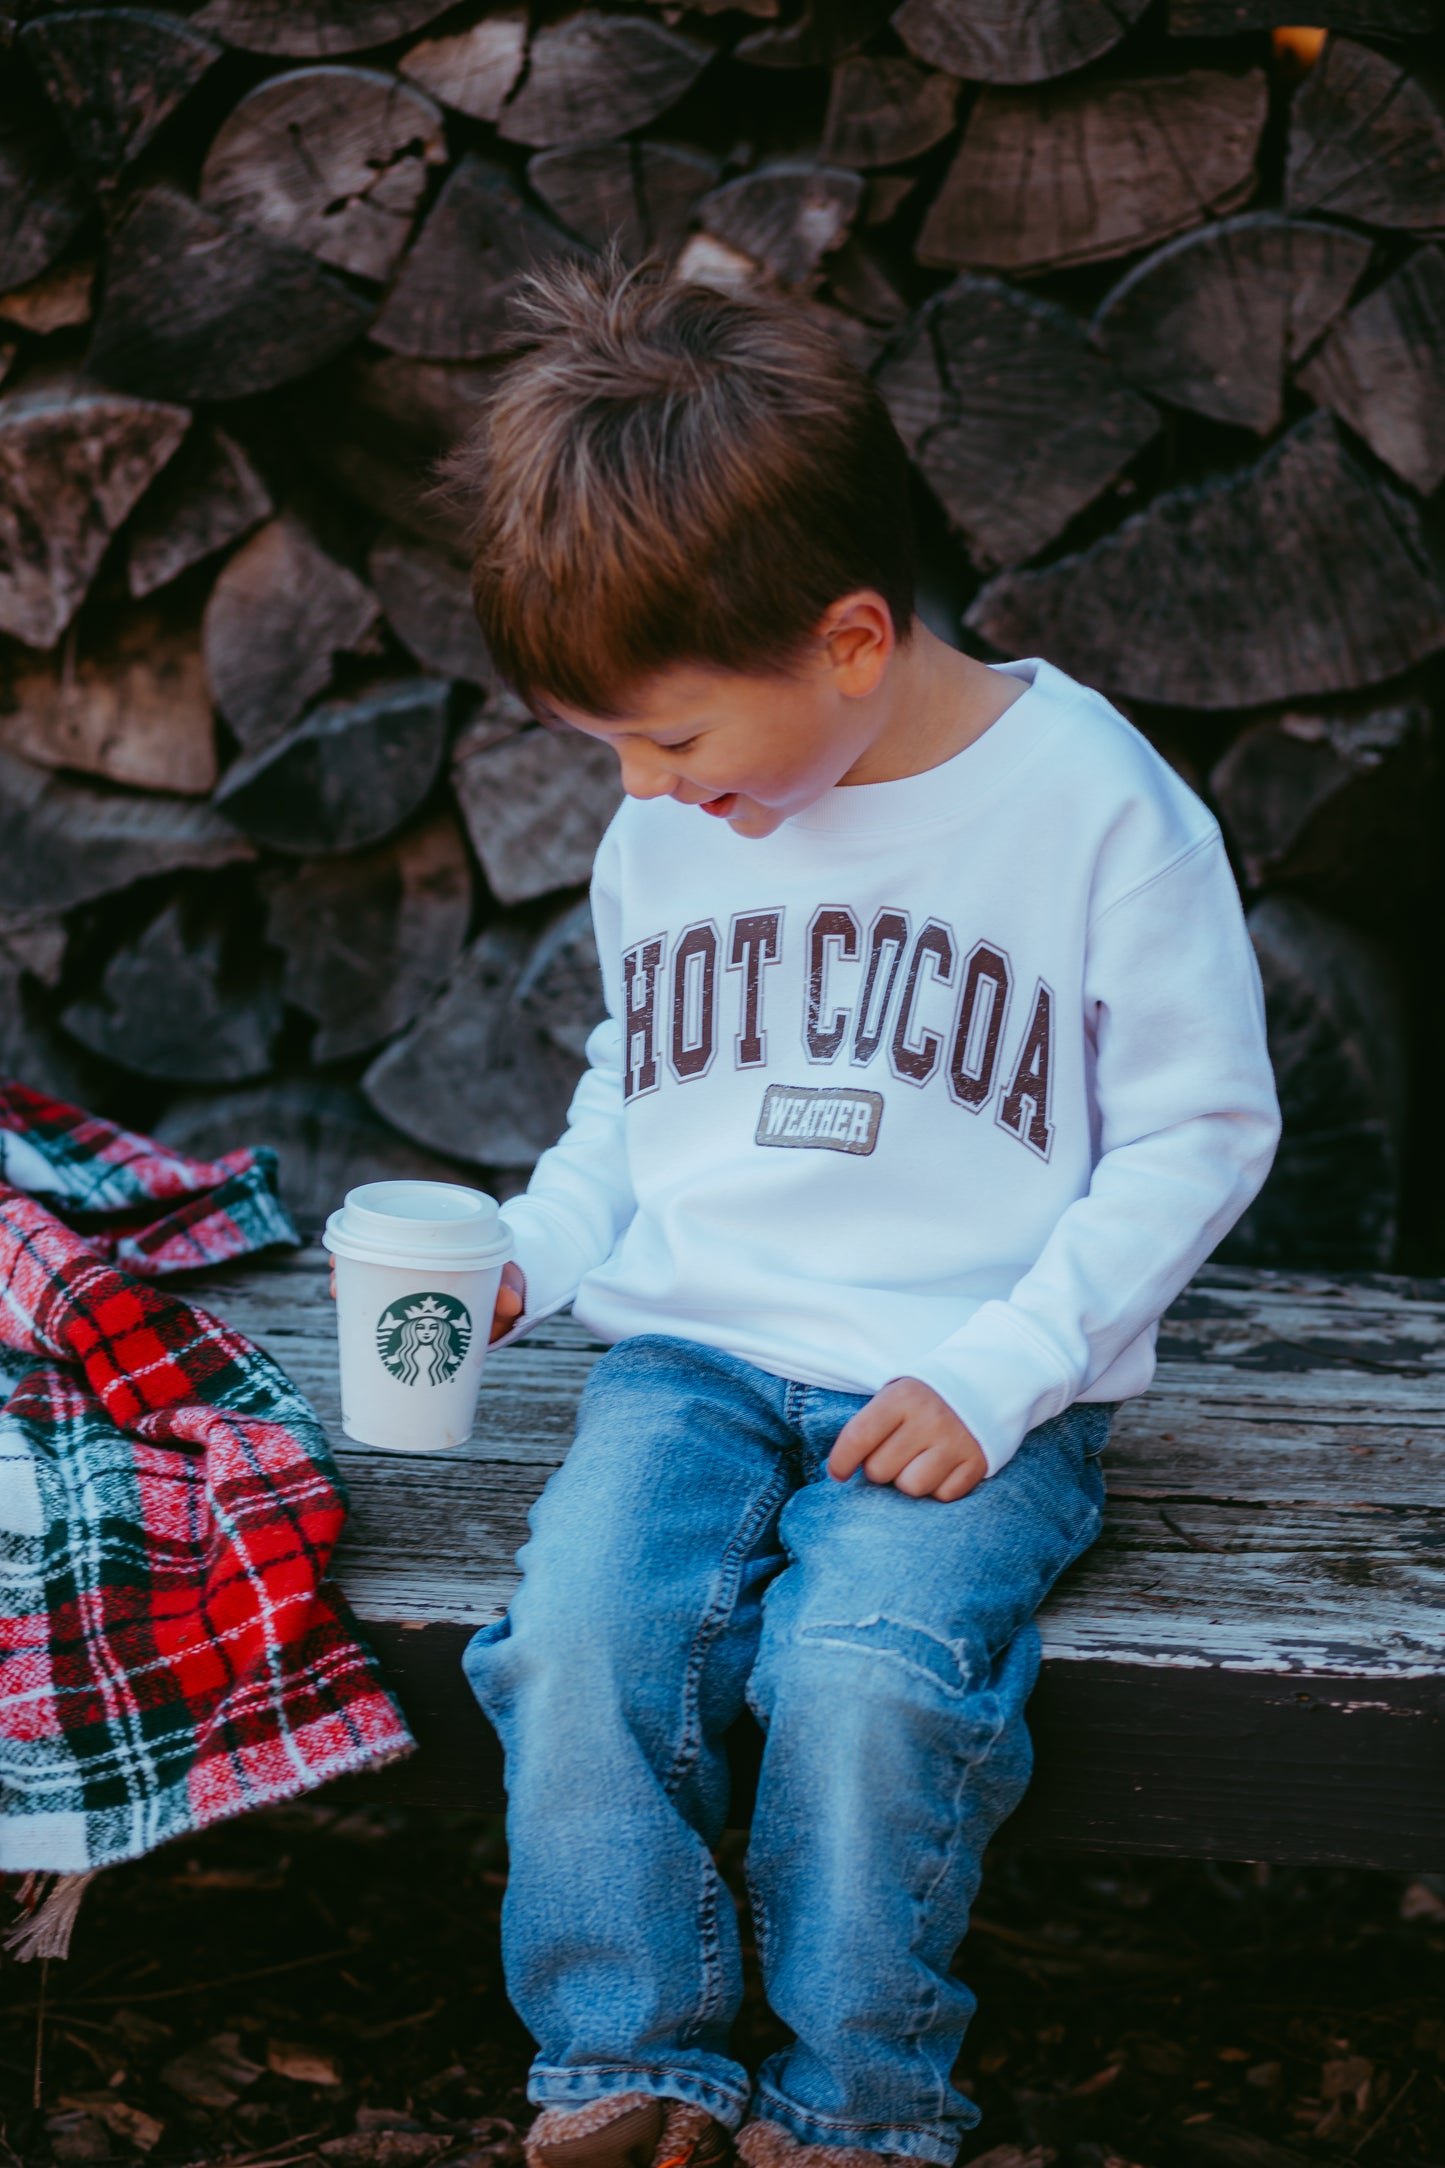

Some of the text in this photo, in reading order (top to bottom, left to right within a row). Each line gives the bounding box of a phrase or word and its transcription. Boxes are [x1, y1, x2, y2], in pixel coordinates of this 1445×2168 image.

[622, 904, 1055, 1163] HOT COCOA
[766, 1096, 872, 1143] WEATHER
